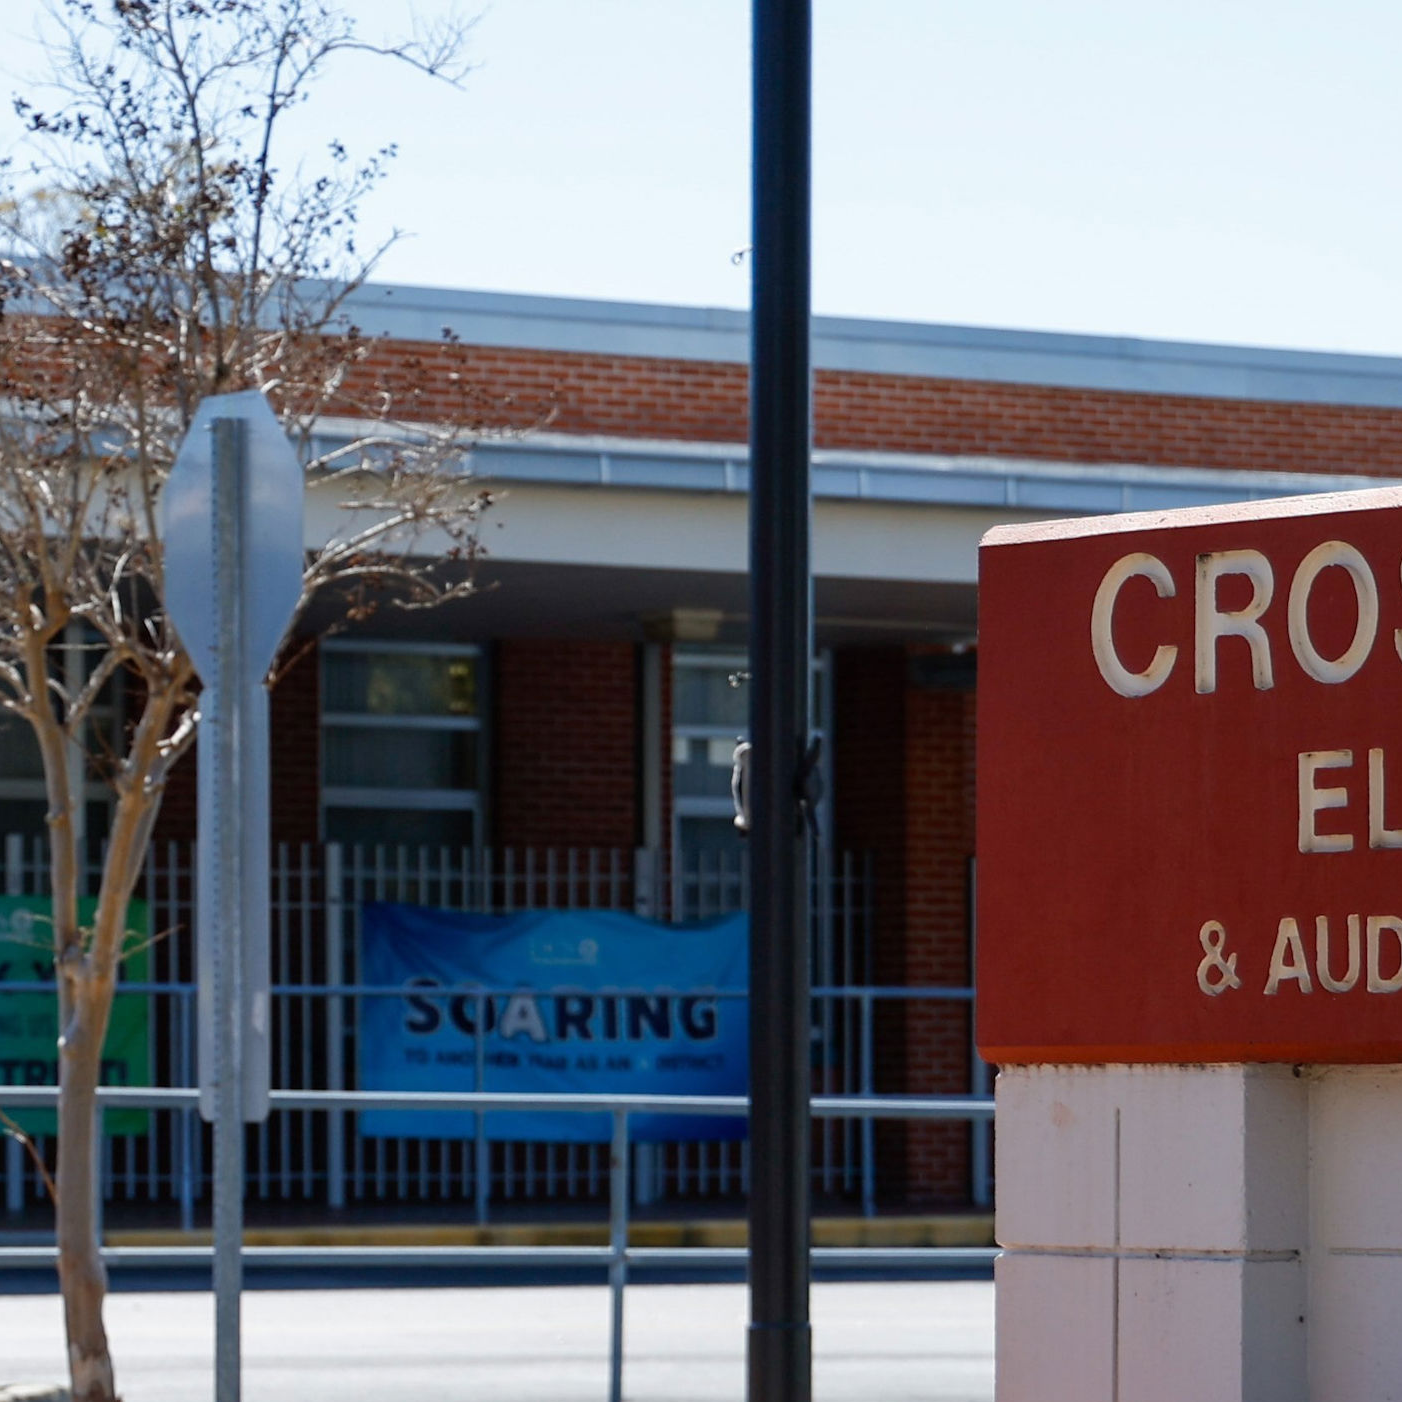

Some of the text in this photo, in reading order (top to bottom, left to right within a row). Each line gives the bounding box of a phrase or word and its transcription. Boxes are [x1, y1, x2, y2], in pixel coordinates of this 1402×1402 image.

[1196, 919, 1240, 996] &
[403, 977, 717, 1042] SOARING
[434, 1051, 520, 1069] ANOHER
